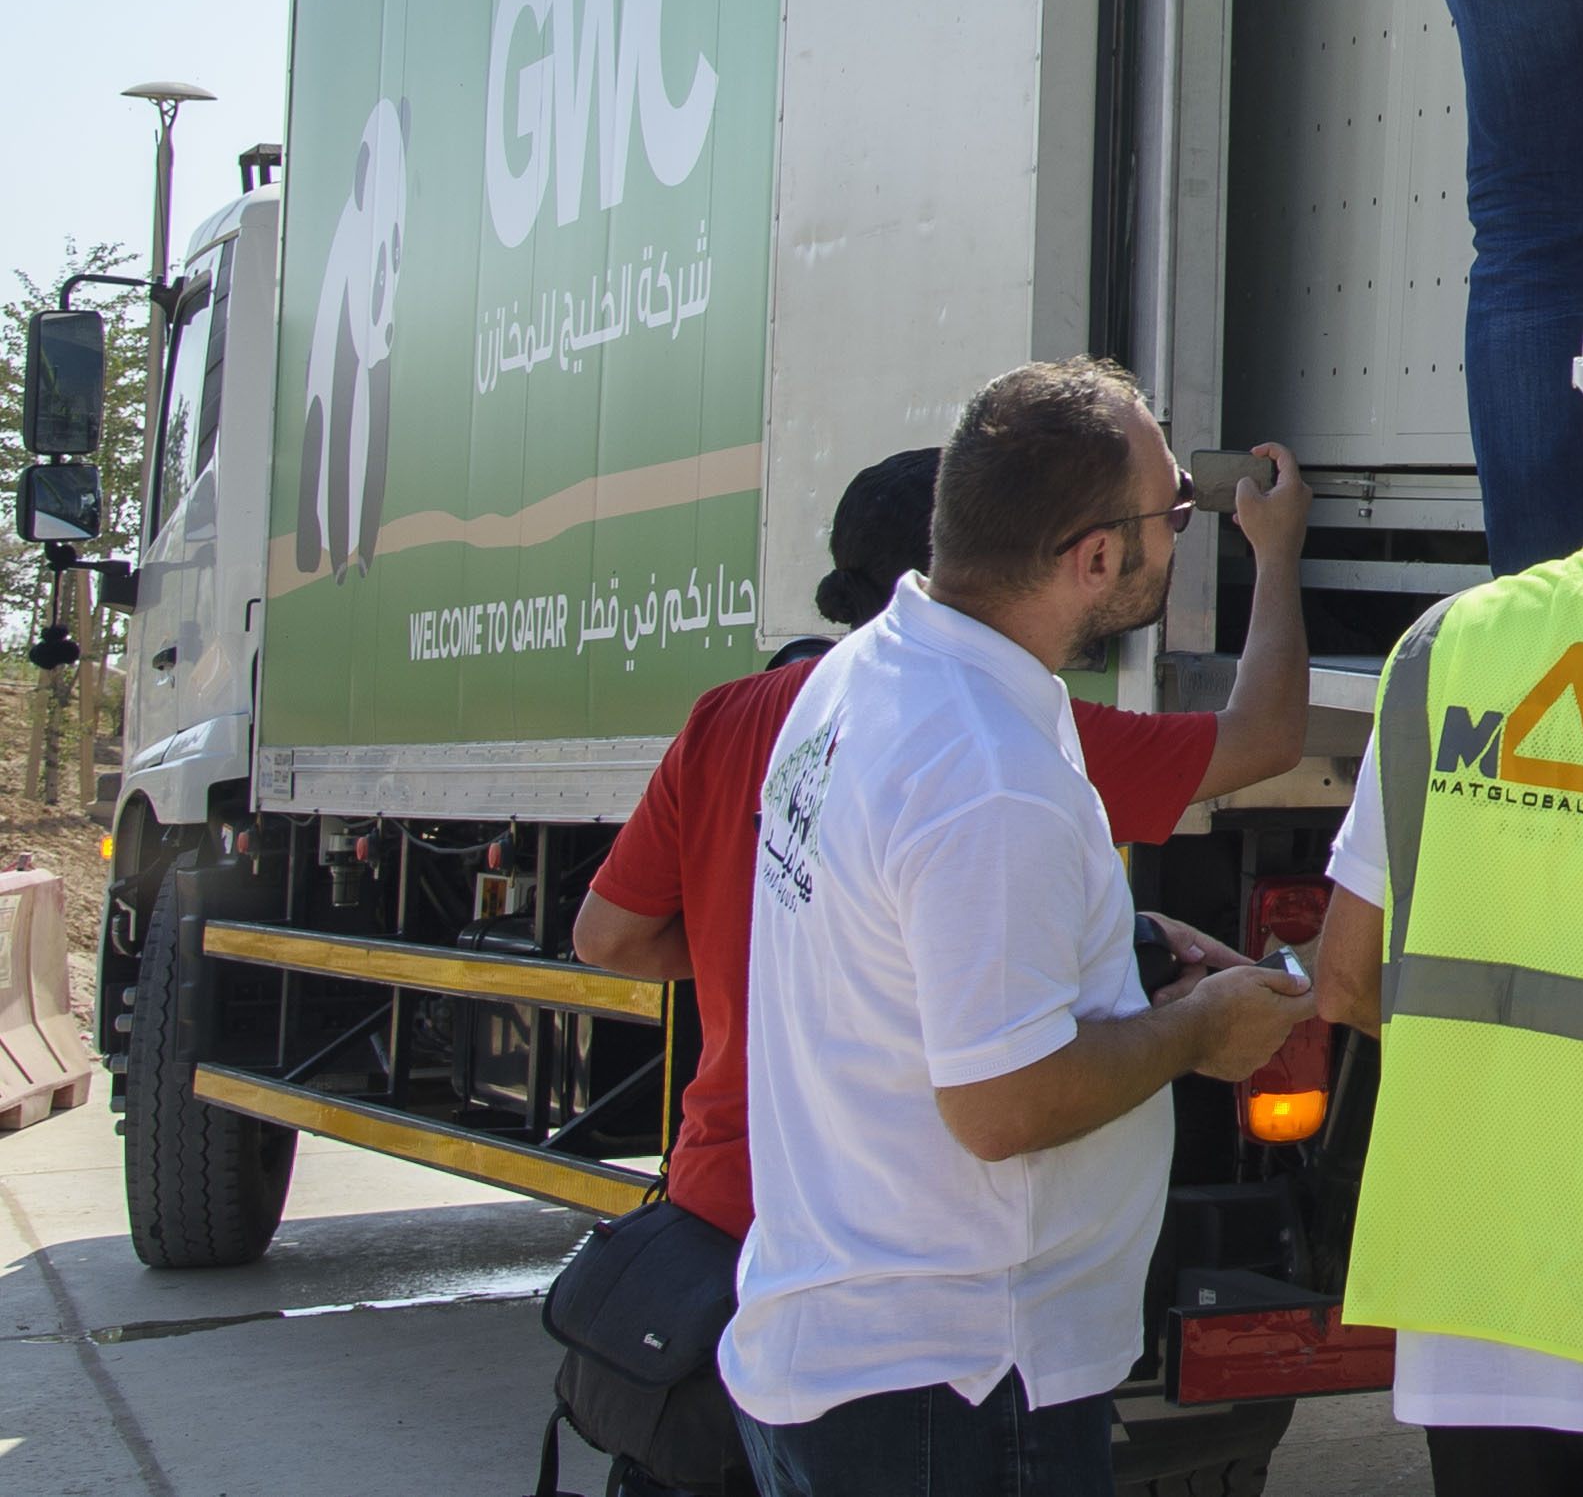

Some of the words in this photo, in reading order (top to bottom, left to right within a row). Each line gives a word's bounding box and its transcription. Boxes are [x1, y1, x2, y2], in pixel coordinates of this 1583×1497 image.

[558, 262, 633, 374] الخليج
[637, 219, 712, 340] شركة
[475, 287, 557, 396] للمخازن
[409, 604, 484, 661] WELCOME
[486, 601, 509, 654] TO
[511, 593, 569, 653] QATAR
[576, 577, 619, 655] قطر
[624, 573, 659, 672] في
[661, 567, 712, 649] بكم
